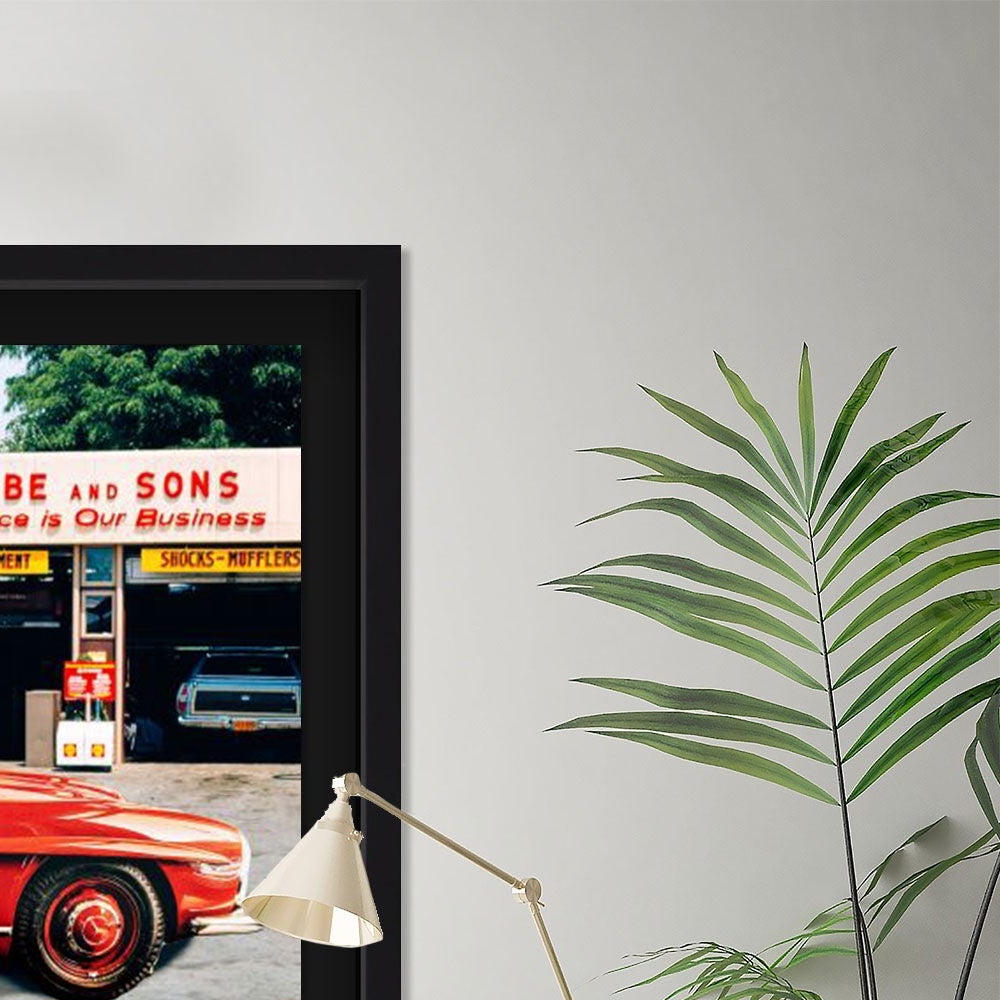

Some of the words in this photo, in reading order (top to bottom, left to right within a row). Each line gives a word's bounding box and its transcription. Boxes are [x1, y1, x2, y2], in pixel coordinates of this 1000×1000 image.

[71, 484, 118, 500] AND
[136, 471, 240, 499] SONS
[41, 510, 62, 528] is
[75, 508, 126, 527] Our
[136, 508, 267, 528] Business
